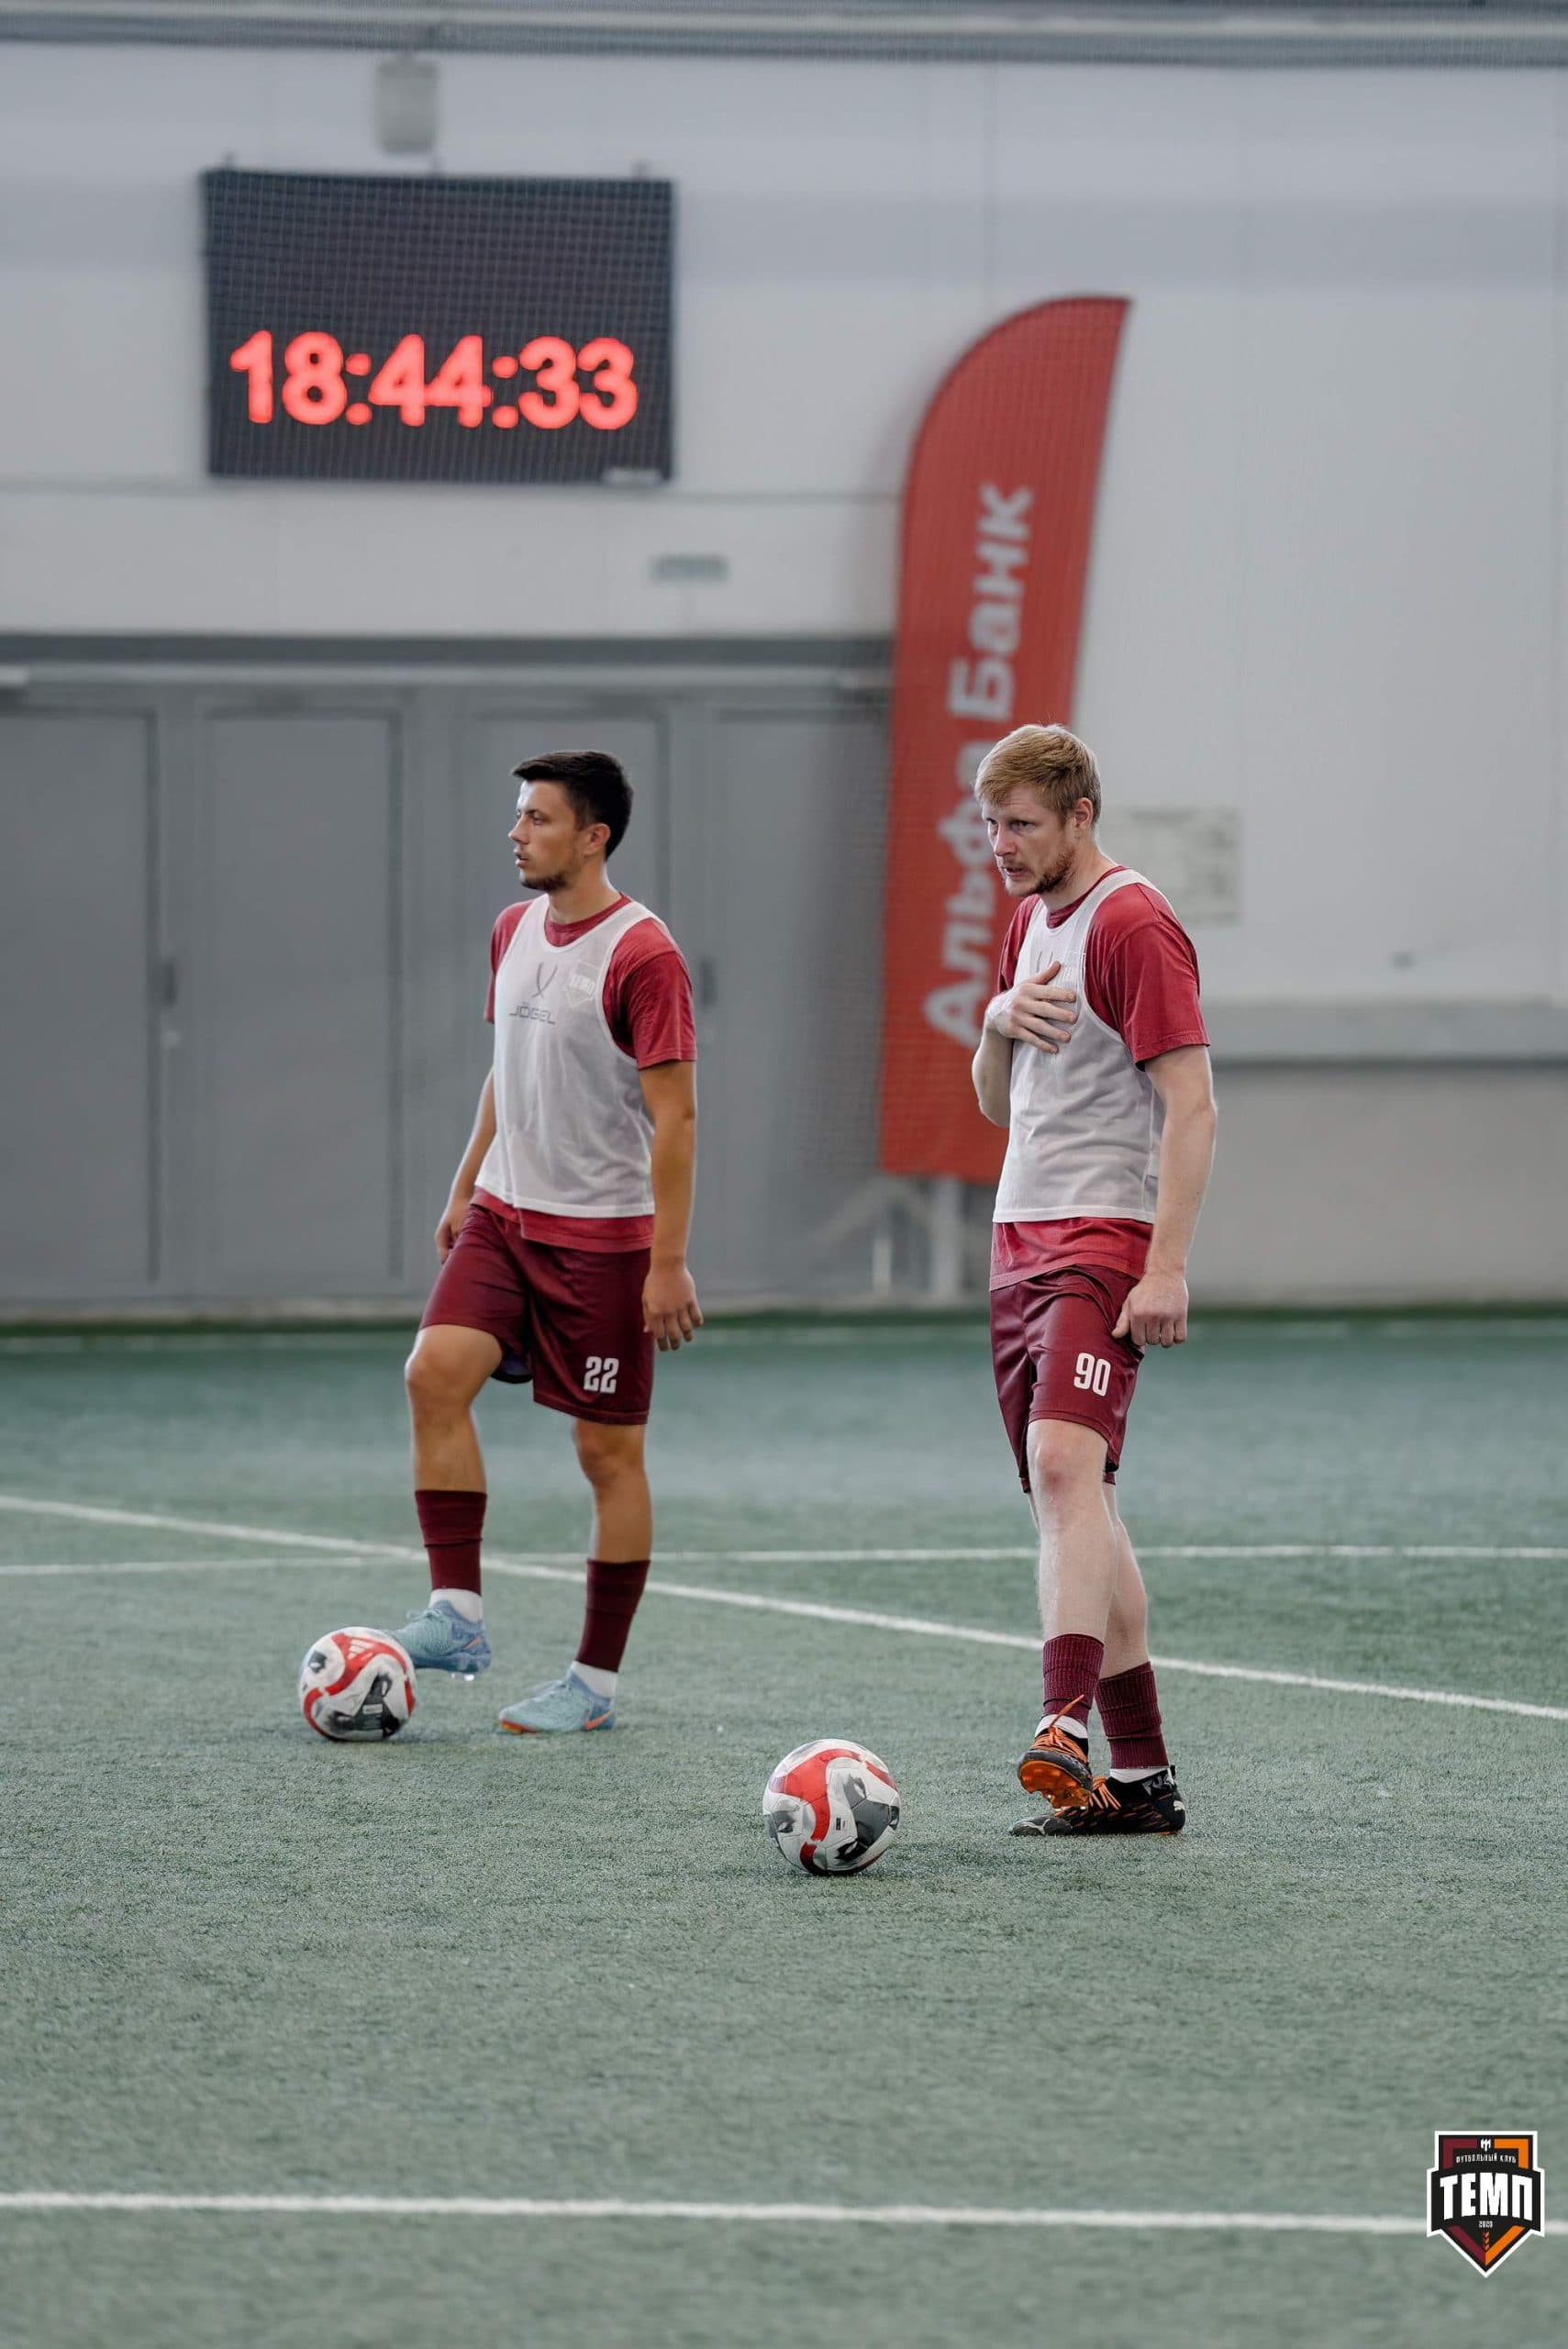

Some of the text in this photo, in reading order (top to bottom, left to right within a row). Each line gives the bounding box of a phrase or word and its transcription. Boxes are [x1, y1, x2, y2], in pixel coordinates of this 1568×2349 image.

[228, 329, 639, 430] 18:44:33
[946, 480, 1035, 722] Банк
[583, 1355, 620, 1394] 22
[1073, 1352, 1112, 1397] 90
